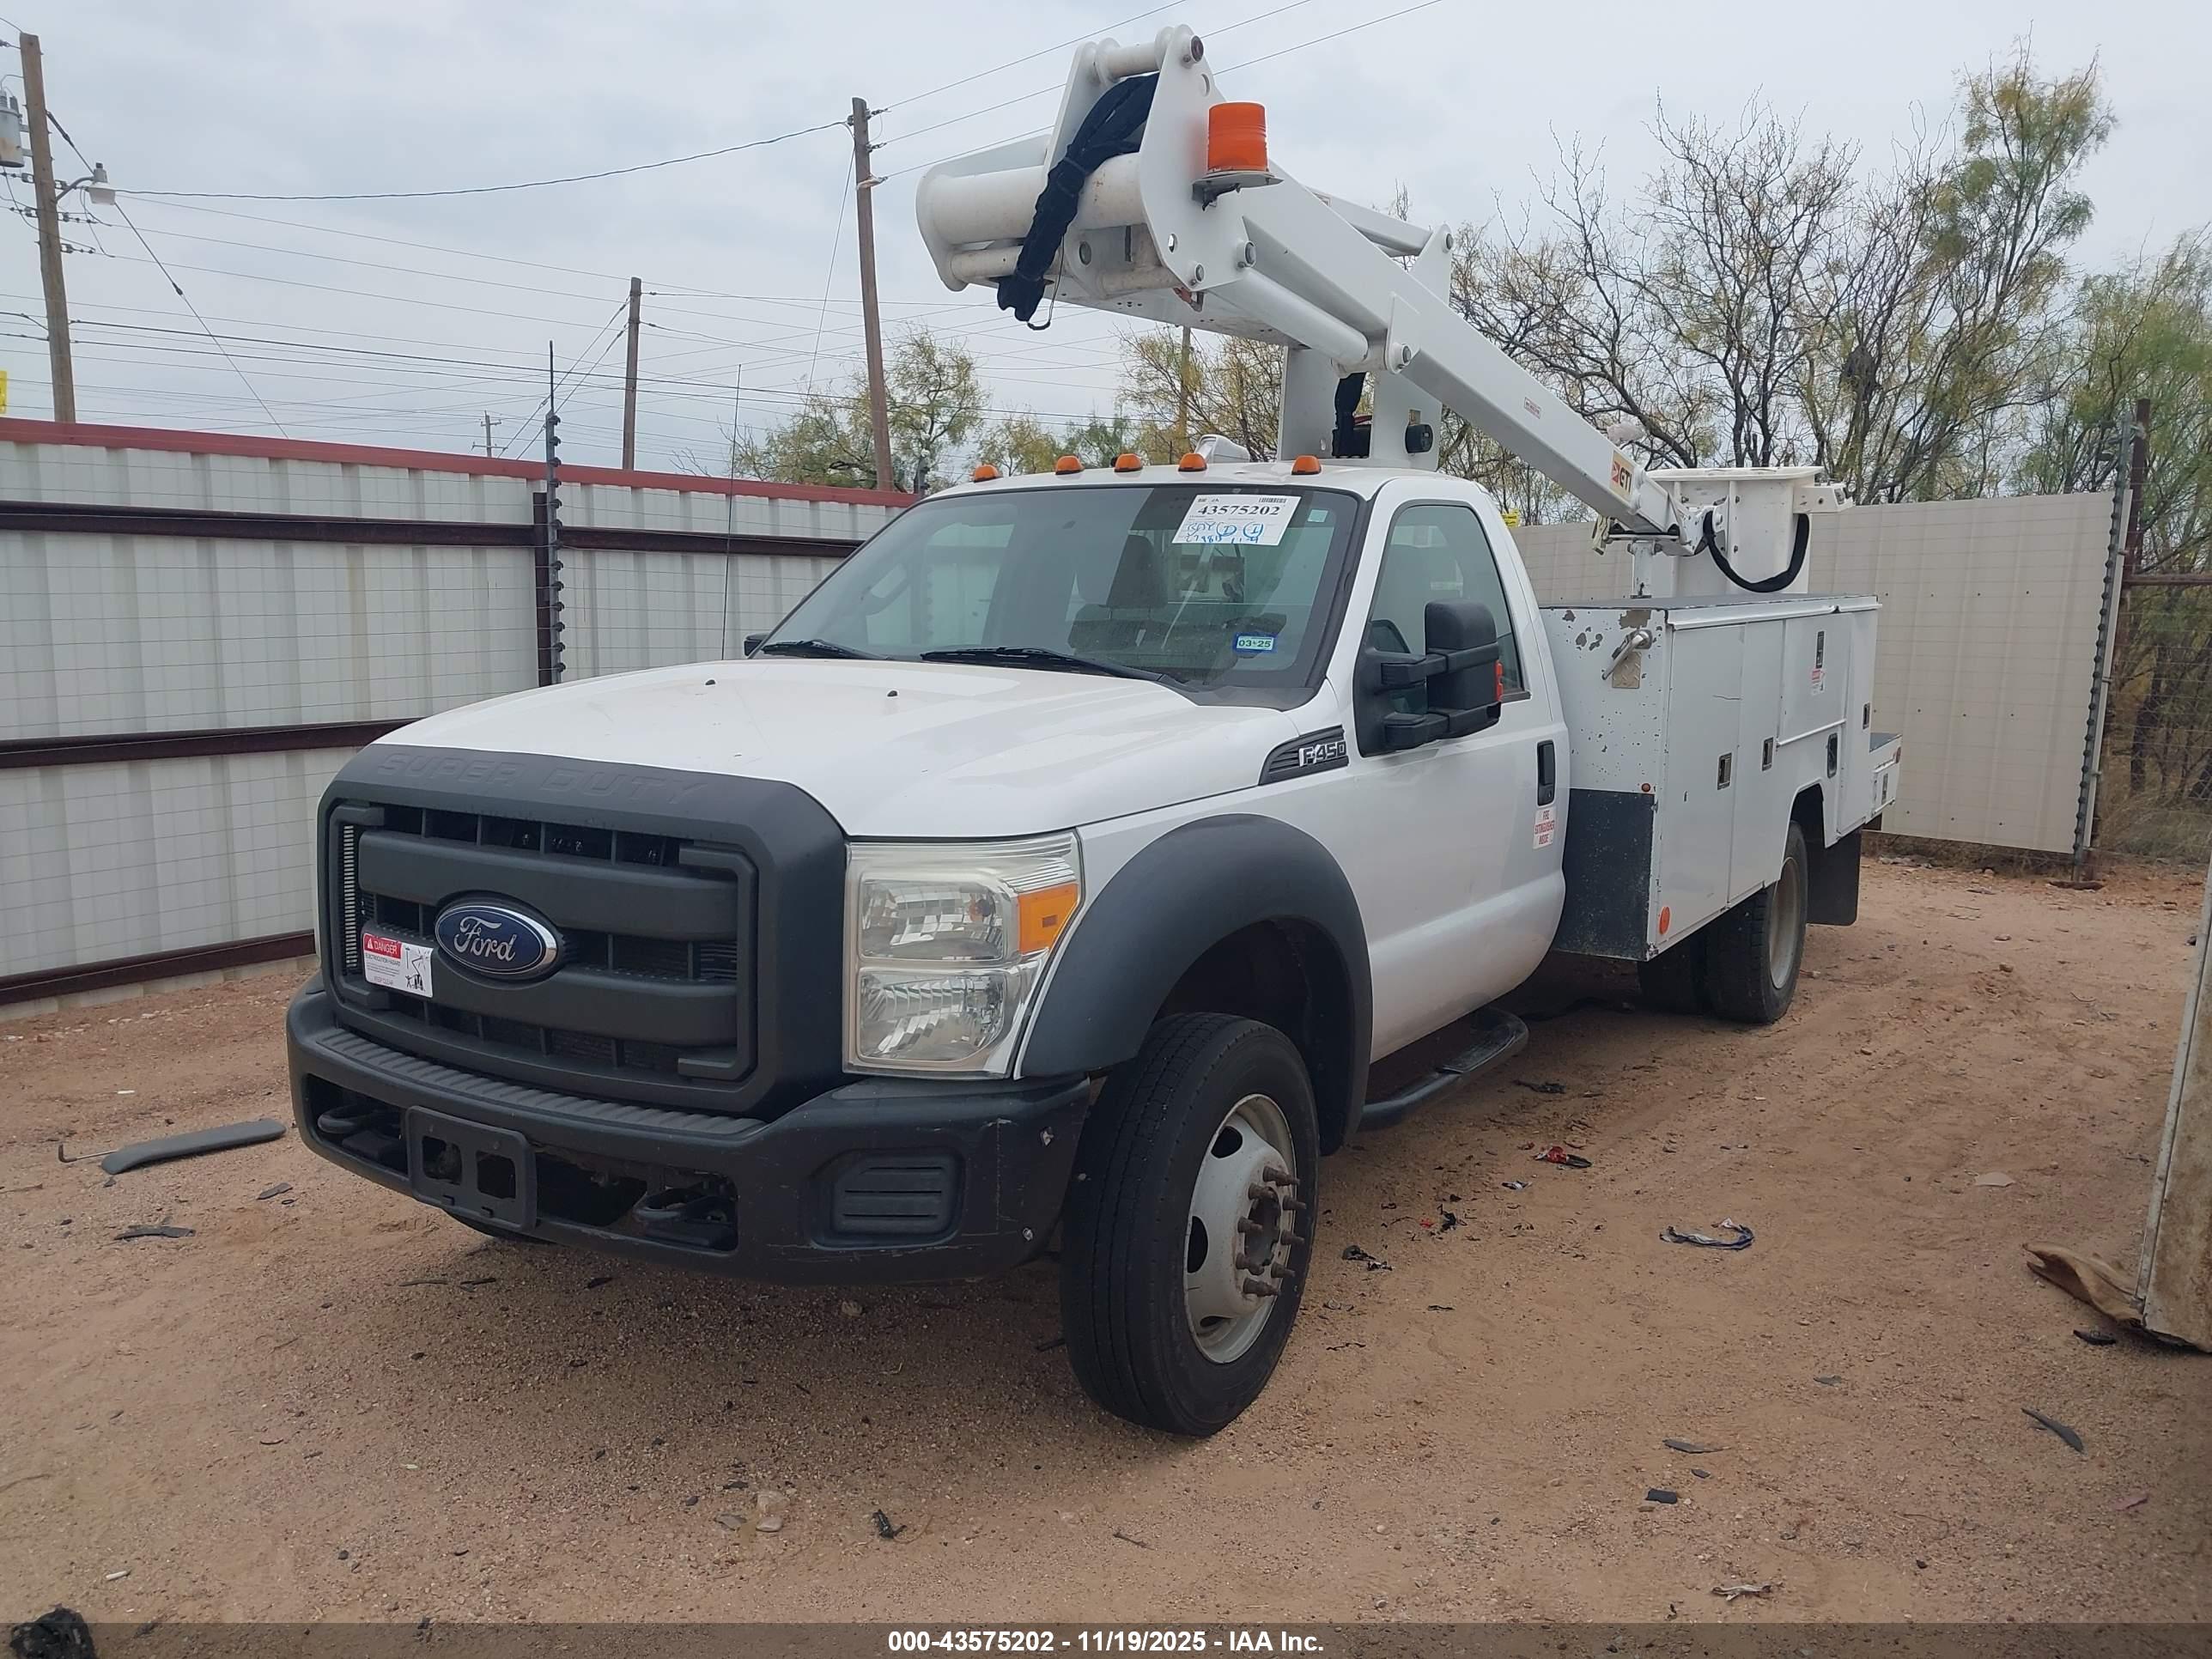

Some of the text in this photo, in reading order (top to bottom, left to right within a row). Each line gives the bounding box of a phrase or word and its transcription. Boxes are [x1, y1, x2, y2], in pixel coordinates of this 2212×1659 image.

[1198, 505, 1280, 515] 43575202
[378, 751, 708, 805] SUPER DUTY
[374, 939, 398, 955] DANGER
[453, 915, 518, 962] Ford
